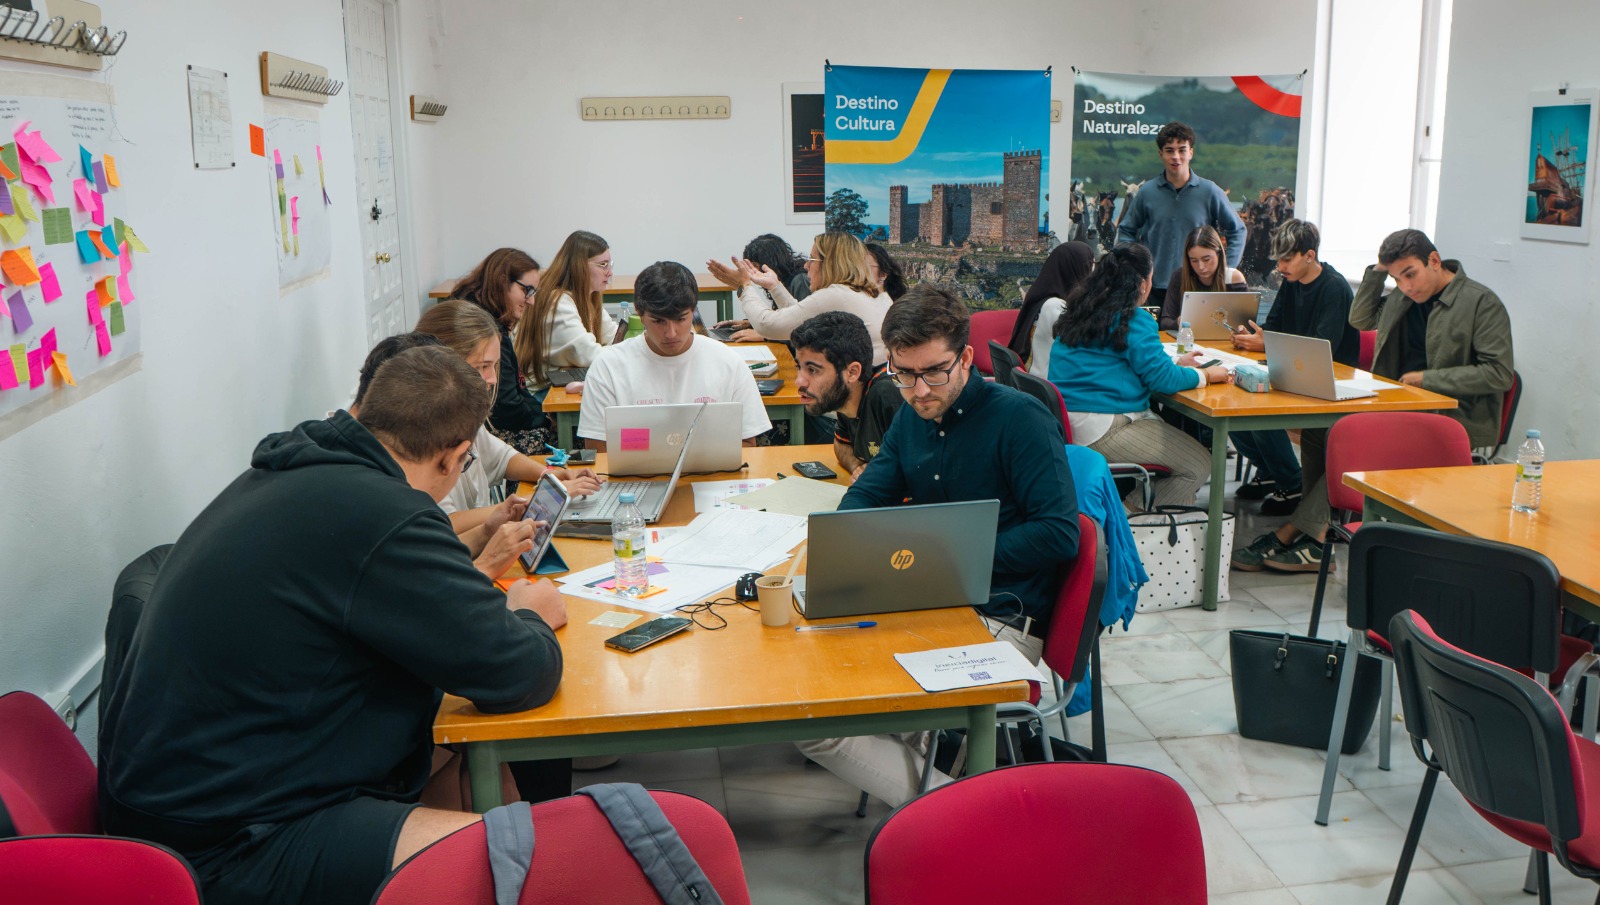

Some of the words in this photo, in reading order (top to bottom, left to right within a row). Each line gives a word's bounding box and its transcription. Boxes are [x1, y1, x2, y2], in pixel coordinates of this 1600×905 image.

[835, 95, 899, 110] Destino
[1083, 99, 1146, 114] Destino
[835, 115, 896, 131] Cultura
[891, 549, 914, 570] hp
